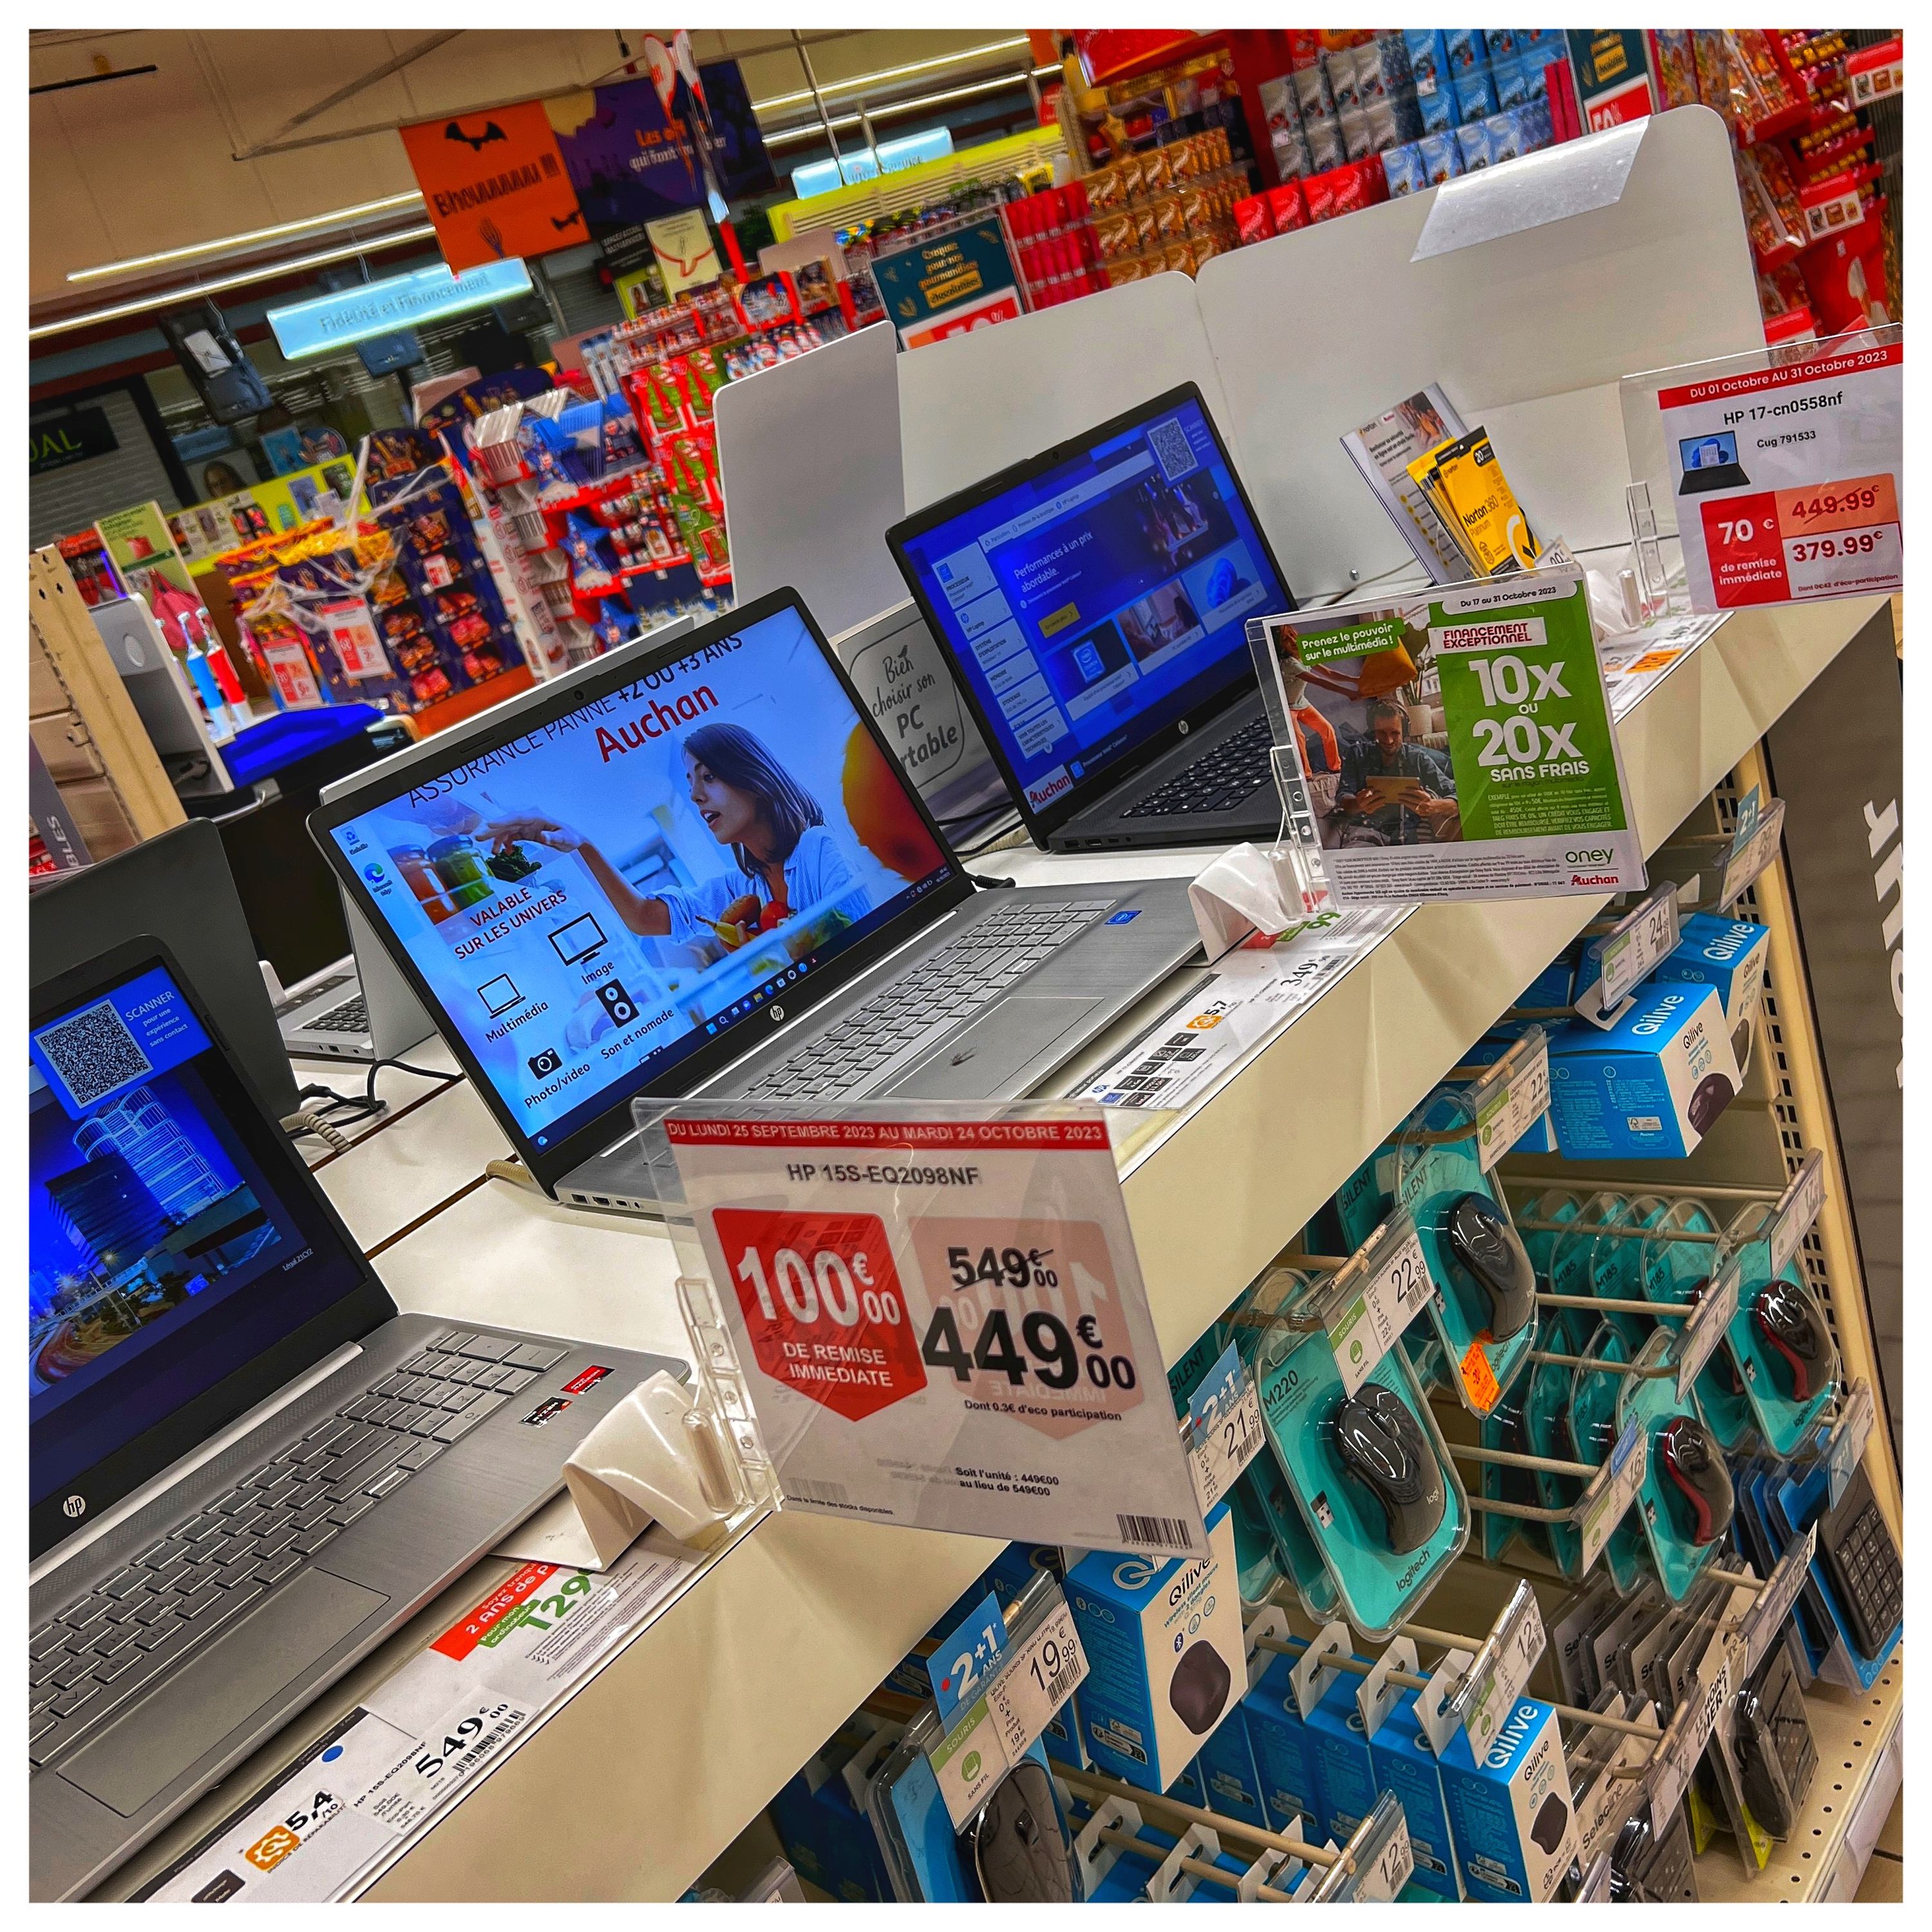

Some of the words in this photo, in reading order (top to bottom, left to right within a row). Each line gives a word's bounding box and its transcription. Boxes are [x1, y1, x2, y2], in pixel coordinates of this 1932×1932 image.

[1690, 385, 1706, 399] DU
[1708, 383, 1720, 395] 01
[1722, 375, 1770, 393] Octobre
[1772, 371, 1788, 383] AU
[1790, 366, 1803, 379] 31
[1804, 357, 1855, 377] Octobre
[1857, 350, 1889, 366] 2023
[1723, 410, 1745, 426] HP
[1748, 391, 1844, 421] 17-cn0558nf
[1756, 439, 1778, 450] Cug
[1779, 430, 1817, 444] 791533
[1462, 504, 1488, 527] Norton
[1484, 495, 1500, 513] 360
[1718, 518, 1754, 546] 70
[1013, 548, 1065, 579] Performances
[1068, 539, 1080, 551] un
[1077, 531, 1094, 548] prix
[1720, 563, 1736, 574] de
[1736, 557, 1777, 573] remise
[1021, 566, 1060, 594] abordable.
[1719, 569, 1783, 586] immédiate
[1460, 599, 1471, 608] Du
[1502, 589, 1537, 602] Octobre
[1538, 586, 1557, 597] 2023
[1302, 634, 1339, 650] Prenez
[1340, 630, 1351, 643] le
[1352, 623, 1394, 643] pouvoir
[1305, 650, 1320, 661] sur
[1321, 646, 1333, 657] le
[1334, 636, 1387, 654] multimédia
[1443, 623, 1529, 640] FINANCEMENT
[1443, 632, 1533, 649] EXCEPTIONNEL
[882, 645, 914, 684] Bien
[872, 683, 913, 718] choisir
[916, 674, 936, 693] son
[408, 732, 544, 809] ASSURANCE
[542, 696, 618, 742] PANNE
[702, 634, 744, 667] ANS
[593, 684, 721, 765] Auchan
[896, 704, 925, 739] PC
[1539, 760, 1591, 779] FRAIS
[1028, 774, 1072, 809] Auchan
[1565, 847, 1614, 866] oney
[1570, 873, 1620, 887] Auchan
[453, 936, 484, 961] SUR
[484, 922, 511, 947] LES
[508, 889, 569, 931] UNIVERS
[469, 886, 533, 929] VALABLE
[1649, 910, 1663, 946] 24
[1703, 921, 1756, 961] Qilive
[580, 960, 616, 985] Image
[1280, 962, 1320, 987] 349
[124, 990, 176, 1022] SCANNER
[142, 1014, 158, 1027] pour
[158, 1007, 172, 1019] une
[484, 998, 550, 1044] Multimédia
[1631, 992, 1685, 1036] Qilive
[146, 1015, 180, 1037] expérience
[149, 1036, 166, 1048] sans
[165, 1023, 189, 1040] contact
[600, 1041, 623, 1061] Son
[632, 1008, 676, 1040] nomade
[1682, 1020, 1705, 1051] Qilive
[523, 1061, 592, 1110] Photo/video
[1530, 1072, 1544, 1103] 22
[667, 1122, 687, 1137] DU
[688, 1123, 732, 1138] LUNDI
[732, 1124, 750, 1138] 25
[751, 1124, 841, 1139] SEPTEMBRE
[842, 1124, 876, 1140] 2023
[878, 1125, 900, 1140] AU
[902, 1125, 954, 1141] MARDI
[955, 1125, 975, 1141] 24
[978, 1125, 1060, 1141] OCTOBRE
[1063, 1125, 1103, 1141] 2023
[786, 1162, 816, 1182] HP
[824, 1164, 980, 1186] 15S-EQ2098NF
[1343, 1170, 1372, 1211] SILENT
[947, 1245, 1032, 1292] 549
[1391, 1257, 1417, 1304] 22
[1414, 1260, 1426, 1280] 99
[1553, 1258, 1578, 1287] M185
[1595, 1263, 1618, 1291] M185
[1647, 1265, 1666, 1291] M185
[736, 1245, 855, 1329] 100
[864, 1291, 902, 1326] 00
[1338, 1312, 1358, 1340] SOURIS
[783, 1341, 810, 1360] DE
[814, 1344, 886, 1365] REMISE
[922, 1305, 1083, 1390] 449
[1086, 1356, 1137, 1391] 00
[789, 1363, 894, 1389] IMMEDIATE
[1171, 1344, 1206, 1397] SILENT
[1262, 1369, 1300, 1414] M220
[964, 1399, 991, 1412] Dont
[992, 1402, 1016, 1414] 0.3€
[1018, 1404, 1048, 1417] d'eco
[1050, 1406, 1122, 1422] participation
[1224, 1407, 1247, 1460] 21
[1248, 1408, 1260, 1430] 99
[956, 1465, 977, 1478] Soit
[978, 1467, 1012, 1482] l'unité
[1020, 1473, 1060, 1486] 449€00
[973, 1479, 995, 1491] lieu
[996, 1482, 1010, 1493] de
[1012, 1483, 1050, 1497] 549€00
[1168, 1557, 1212, 1607] Qilive
[1395, 1549, 1432, 1593] logitech
[464, 1624, 480, 1634] 2
[515, 1573, 537, 1594] de
[480, 1587, 507, 1610] Soyez
[516, 1573, 592, 1631] 129
[490, 1604, 532, 1644] ordinateur
[1516, 1620, 1535, 1660] 12
[1030, 1640, 1063, 1692] 19
[1061, 1638, 1077, 1663] 99
[1703, 1668, 1727, 1712] MOINS
[945, 1716, 976, 1754] SOURIS
[1005, 1717, 1021, 1738] Produit
[1484, 1703, 1539, 1770] Qilive
[1697, 1696, 1724, 1747] CHER
[414, 1716, 484, 1779] 549
[489, 1703, 509, 1719] 00
[1522, 1738, 1551, 1783] Qilive
[354, 1795, 366, 1807] HP
[1379, 1842, 1400, 1884] 12
